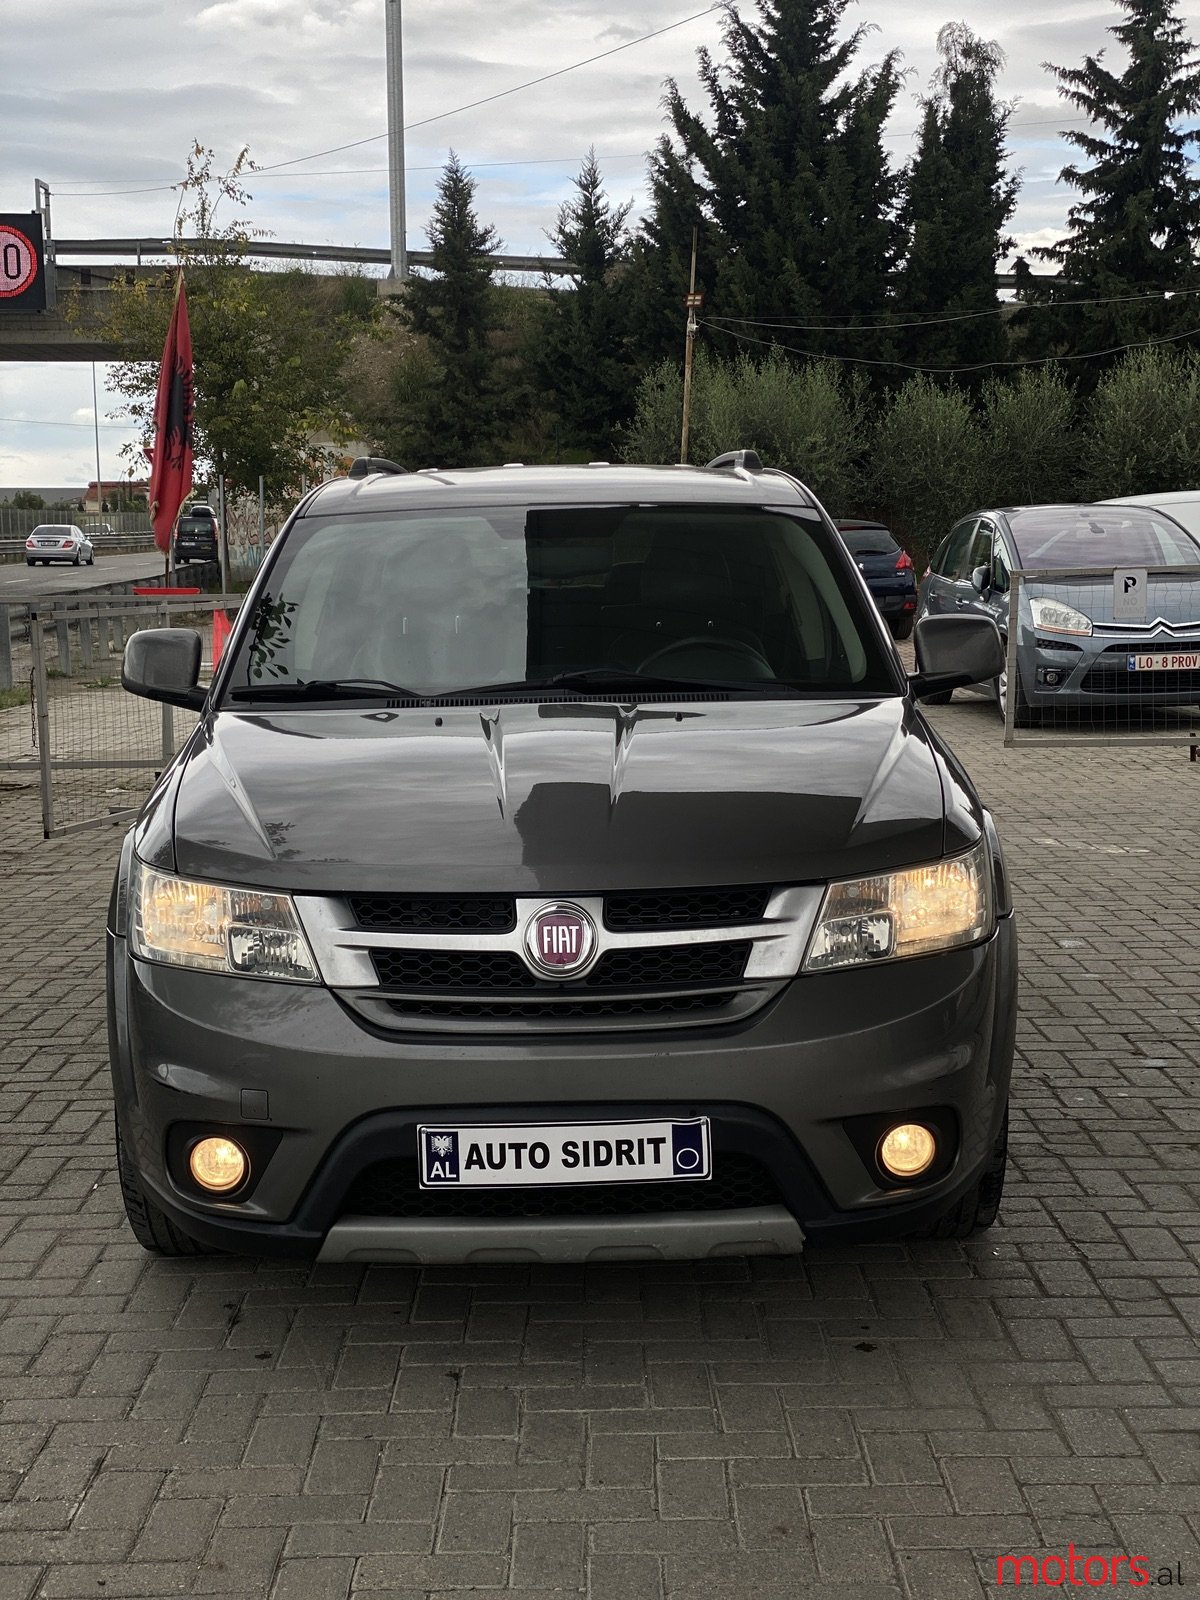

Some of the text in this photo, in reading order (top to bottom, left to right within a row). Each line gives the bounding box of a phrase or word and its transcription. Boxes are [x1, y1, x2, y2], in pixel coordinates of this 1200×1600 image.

[1123, 597, 1138, 606] NO
[1171, 655, 1198, 668] PROV
[543, 925, 579, 954] FIAT
[464, 1136, 667, 1171] AUTO SIDRIT
[430, 1161, 457, 1179] AL
